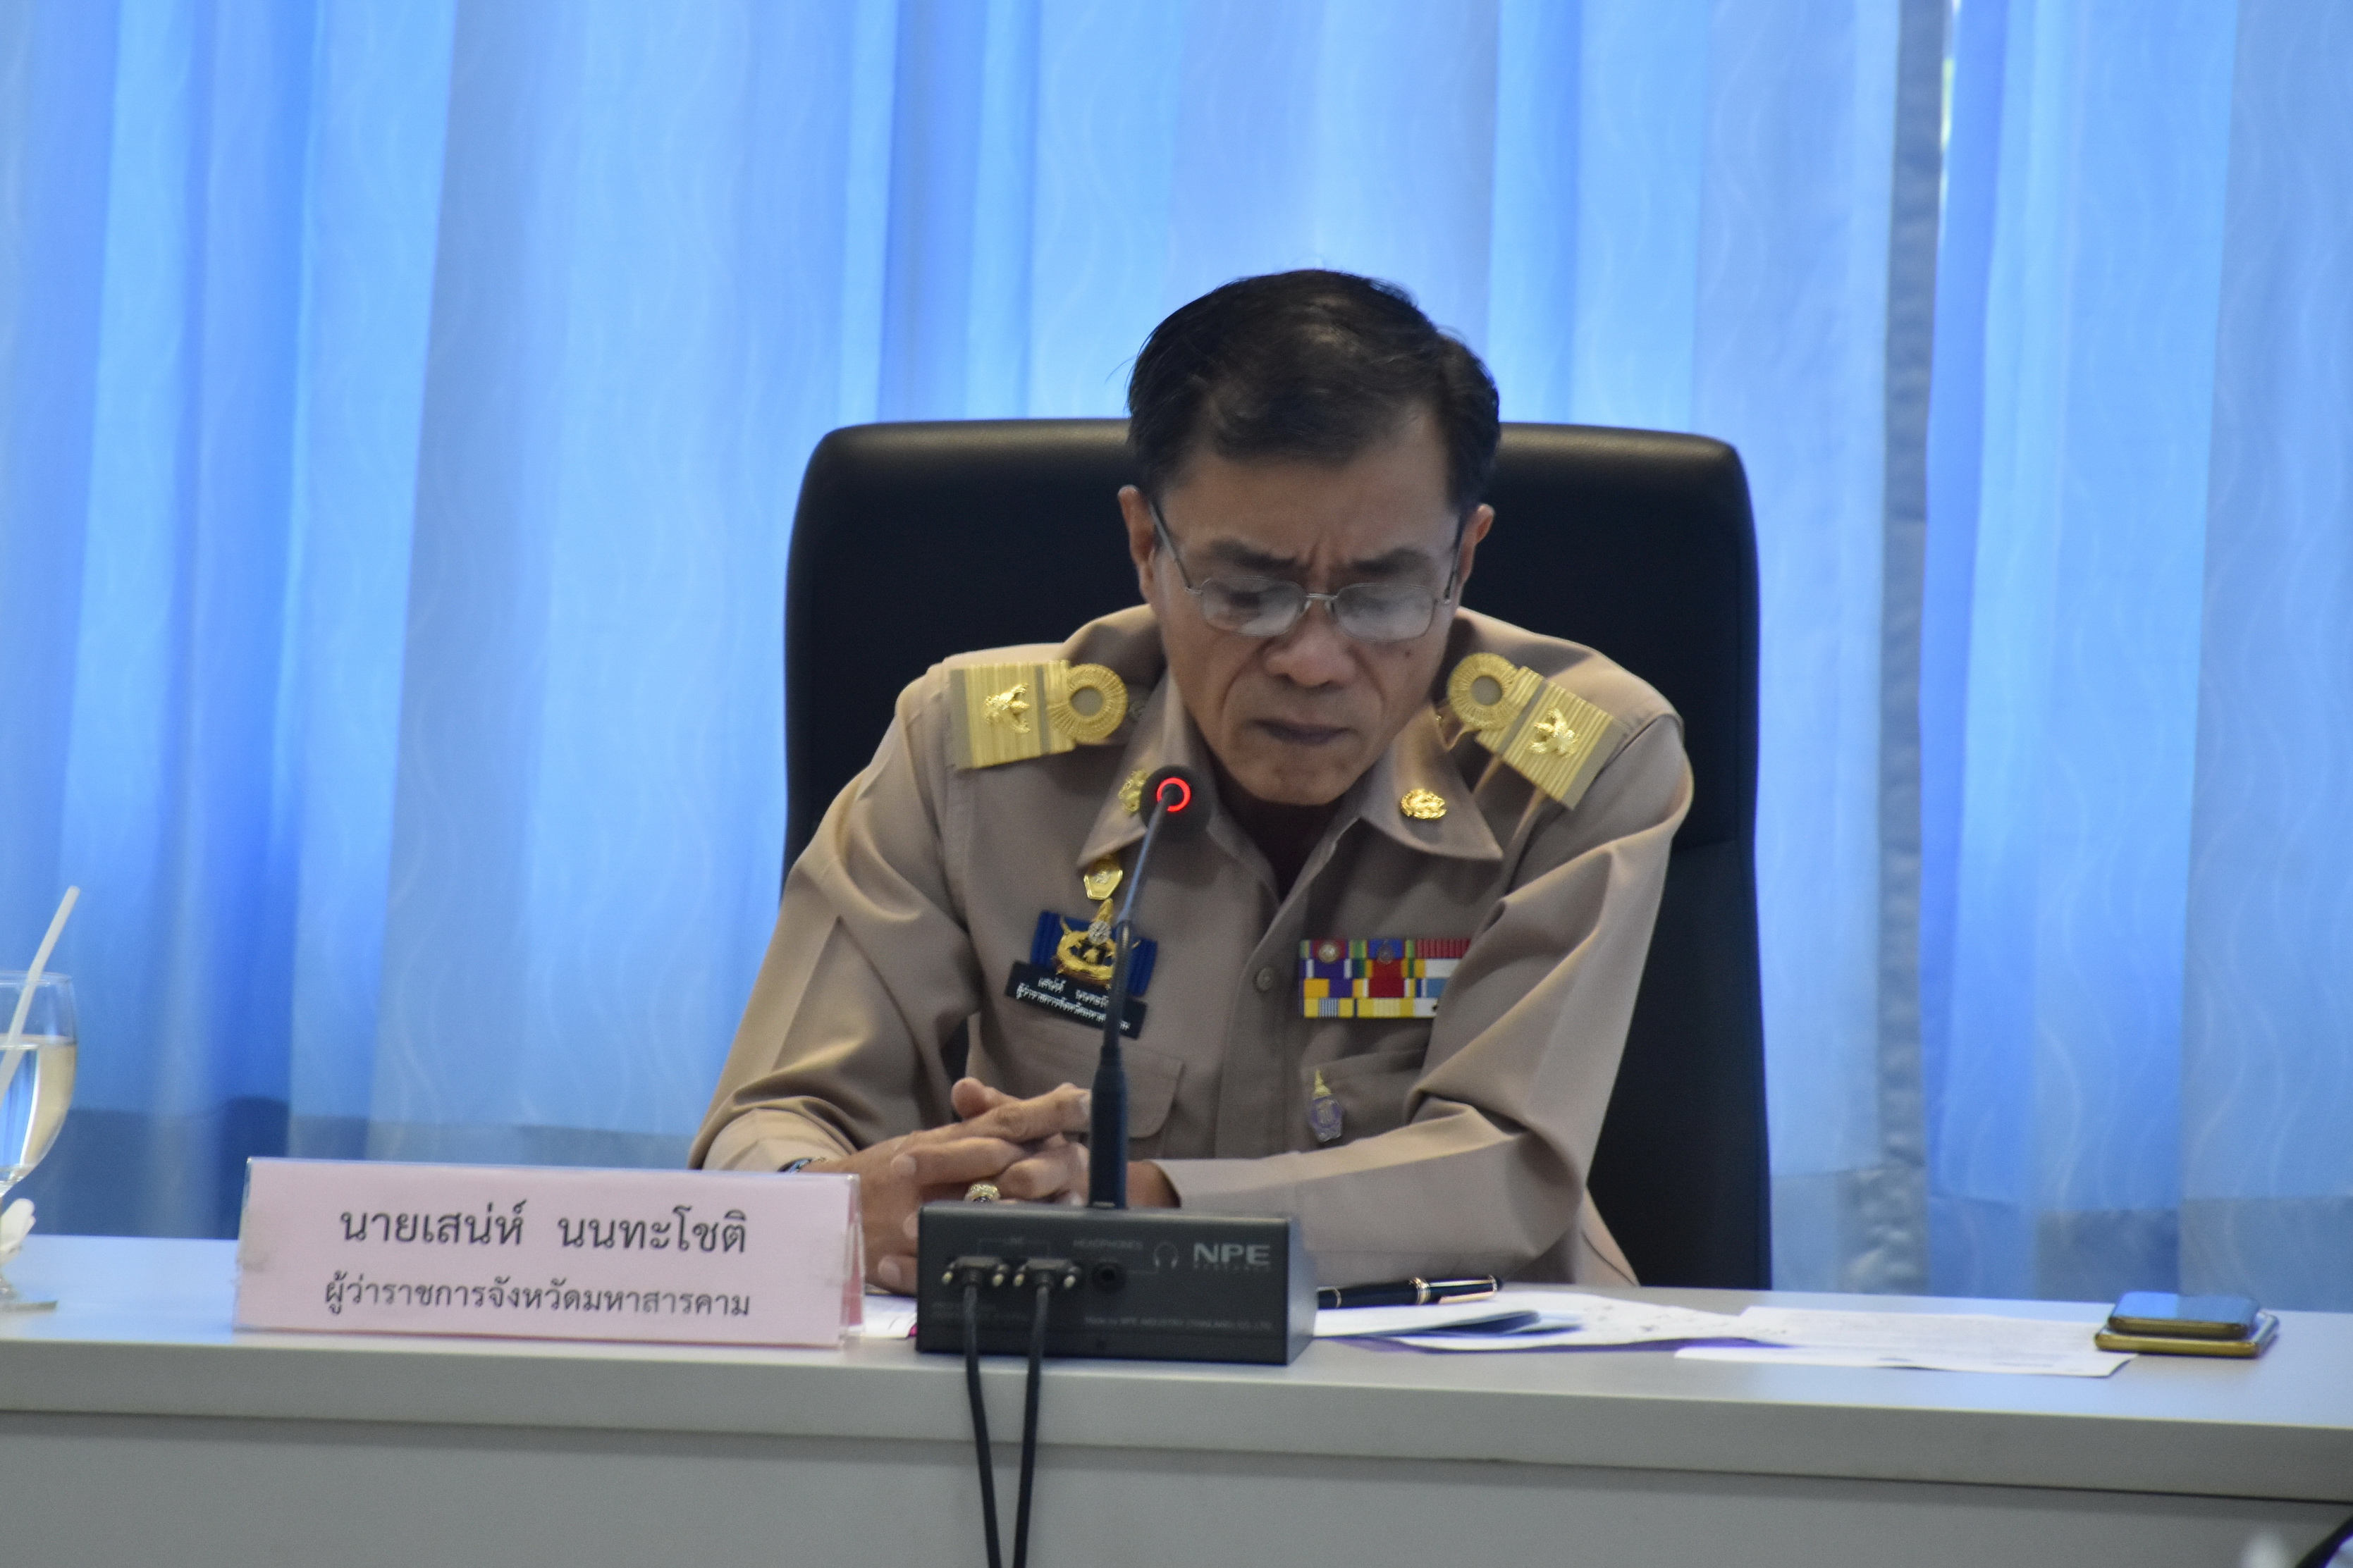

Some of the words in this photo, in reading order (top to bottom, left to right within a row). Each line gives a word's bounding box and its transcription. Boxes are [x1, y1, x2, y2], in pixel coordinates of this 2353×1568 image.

[340, 1199, 527, 1246] นายเสน่ห์
[557, 1204, 747, 1253] นนทะโชติ
[1193, 1242, 1270, 1265] NPE
[325, 1269, 750, 1316] ผู้ว่าราชการจังหวัดมหาสารคาม
